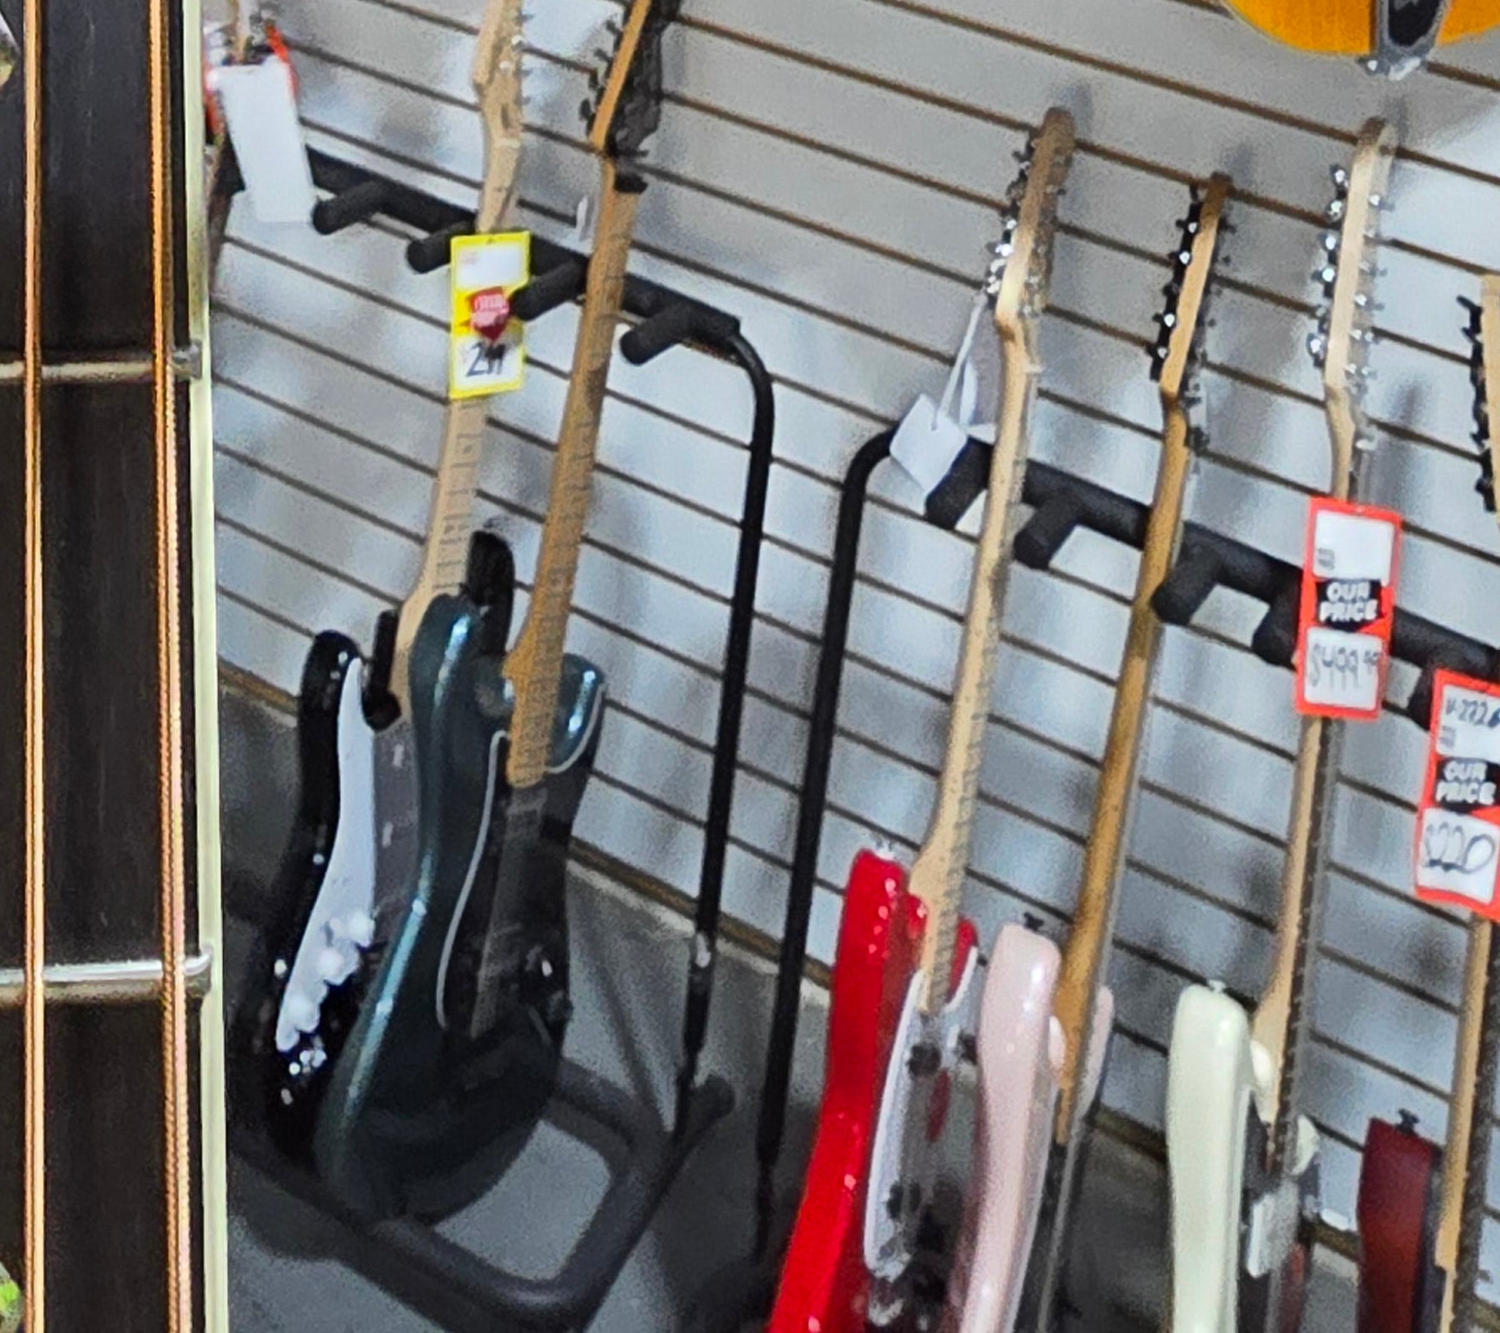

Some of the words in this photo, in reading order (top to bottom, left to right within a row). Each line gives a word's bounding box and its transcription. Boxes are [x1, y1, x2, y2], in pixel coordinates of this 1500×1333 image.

[1326, 581, 1372, 604] OUR
[1319, 599, 1380, 623] PRICE
[1443, 759, 1489, 783] OUR
[1434, 779, 1498, 807] PRICE
